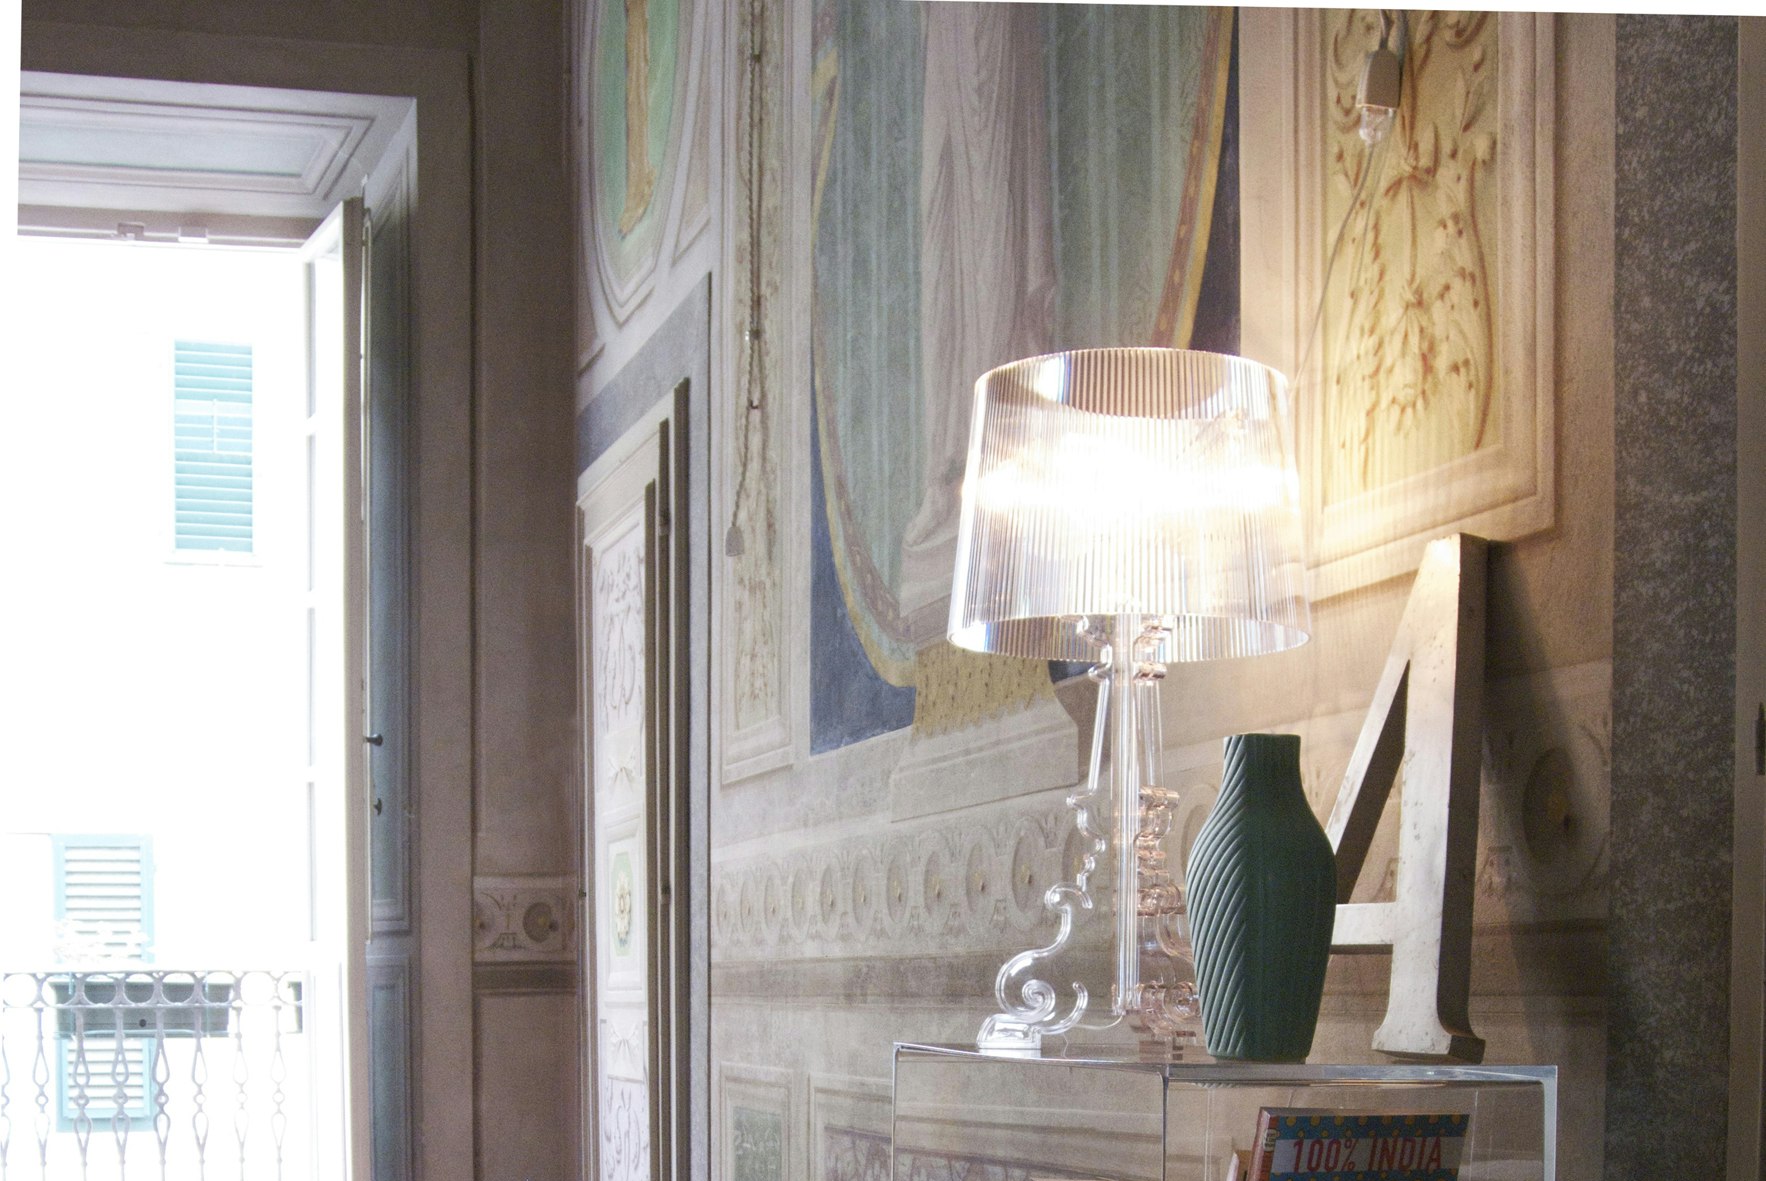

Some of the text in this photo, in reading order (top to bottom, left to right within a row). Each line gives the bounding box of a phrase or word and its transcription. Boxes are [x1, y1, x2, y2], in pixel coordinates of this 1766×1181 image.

[1326, 533, 1487, 1061] A
[1293, 1135, 1441, 1173] 100% INDIA
